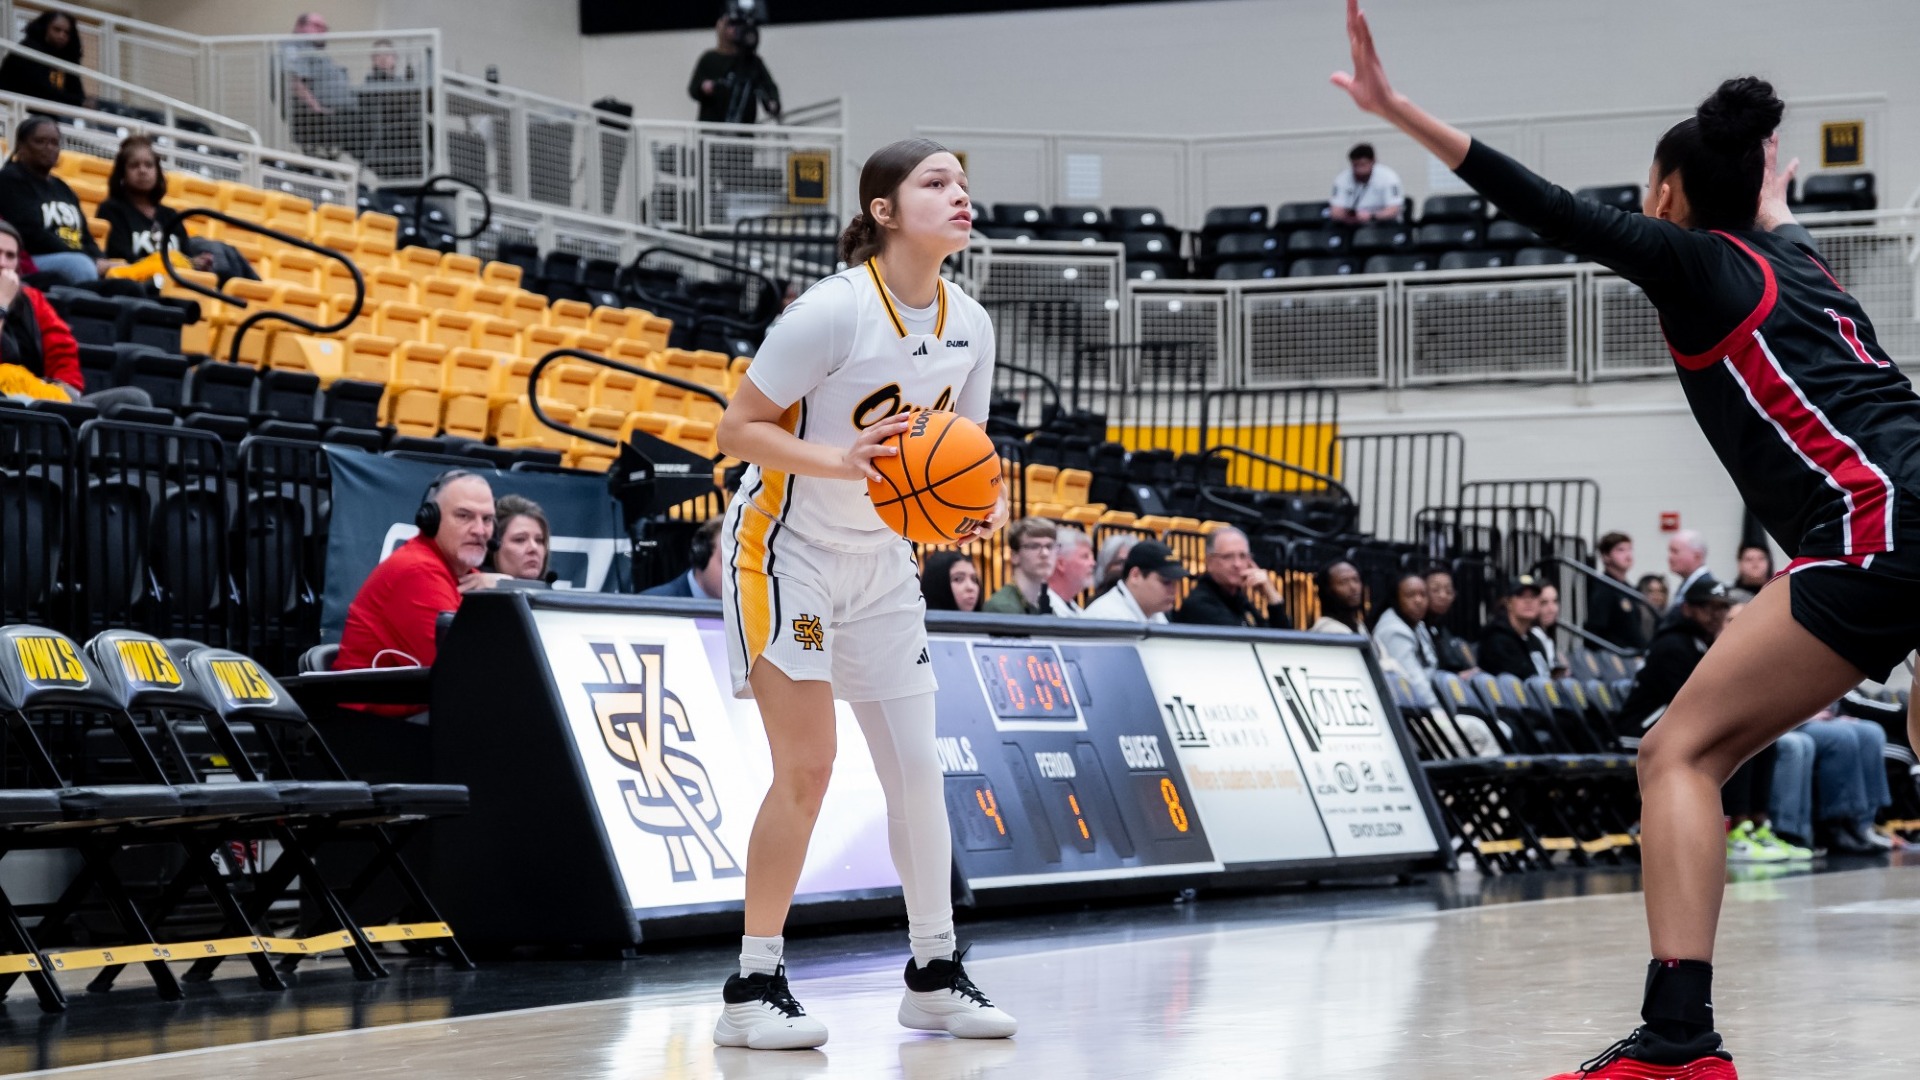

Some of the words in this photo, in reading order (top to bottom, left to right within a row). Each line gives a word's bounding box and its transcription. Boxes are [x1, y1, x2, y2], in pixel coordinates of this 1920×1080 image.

[16, 637, 88, 682] OWLS
[116, 640, 182, 684] OWLS
[211, 661, 274, 700] OWLS
[1034, 752, 1077, 778] PERIOD
[1118, 735, 1166, 769] GUEST
[975, 790, 1006, 835] 4
[1068, 794, 1090, 840] 1
[1160, 777, 1189, 832] 8
